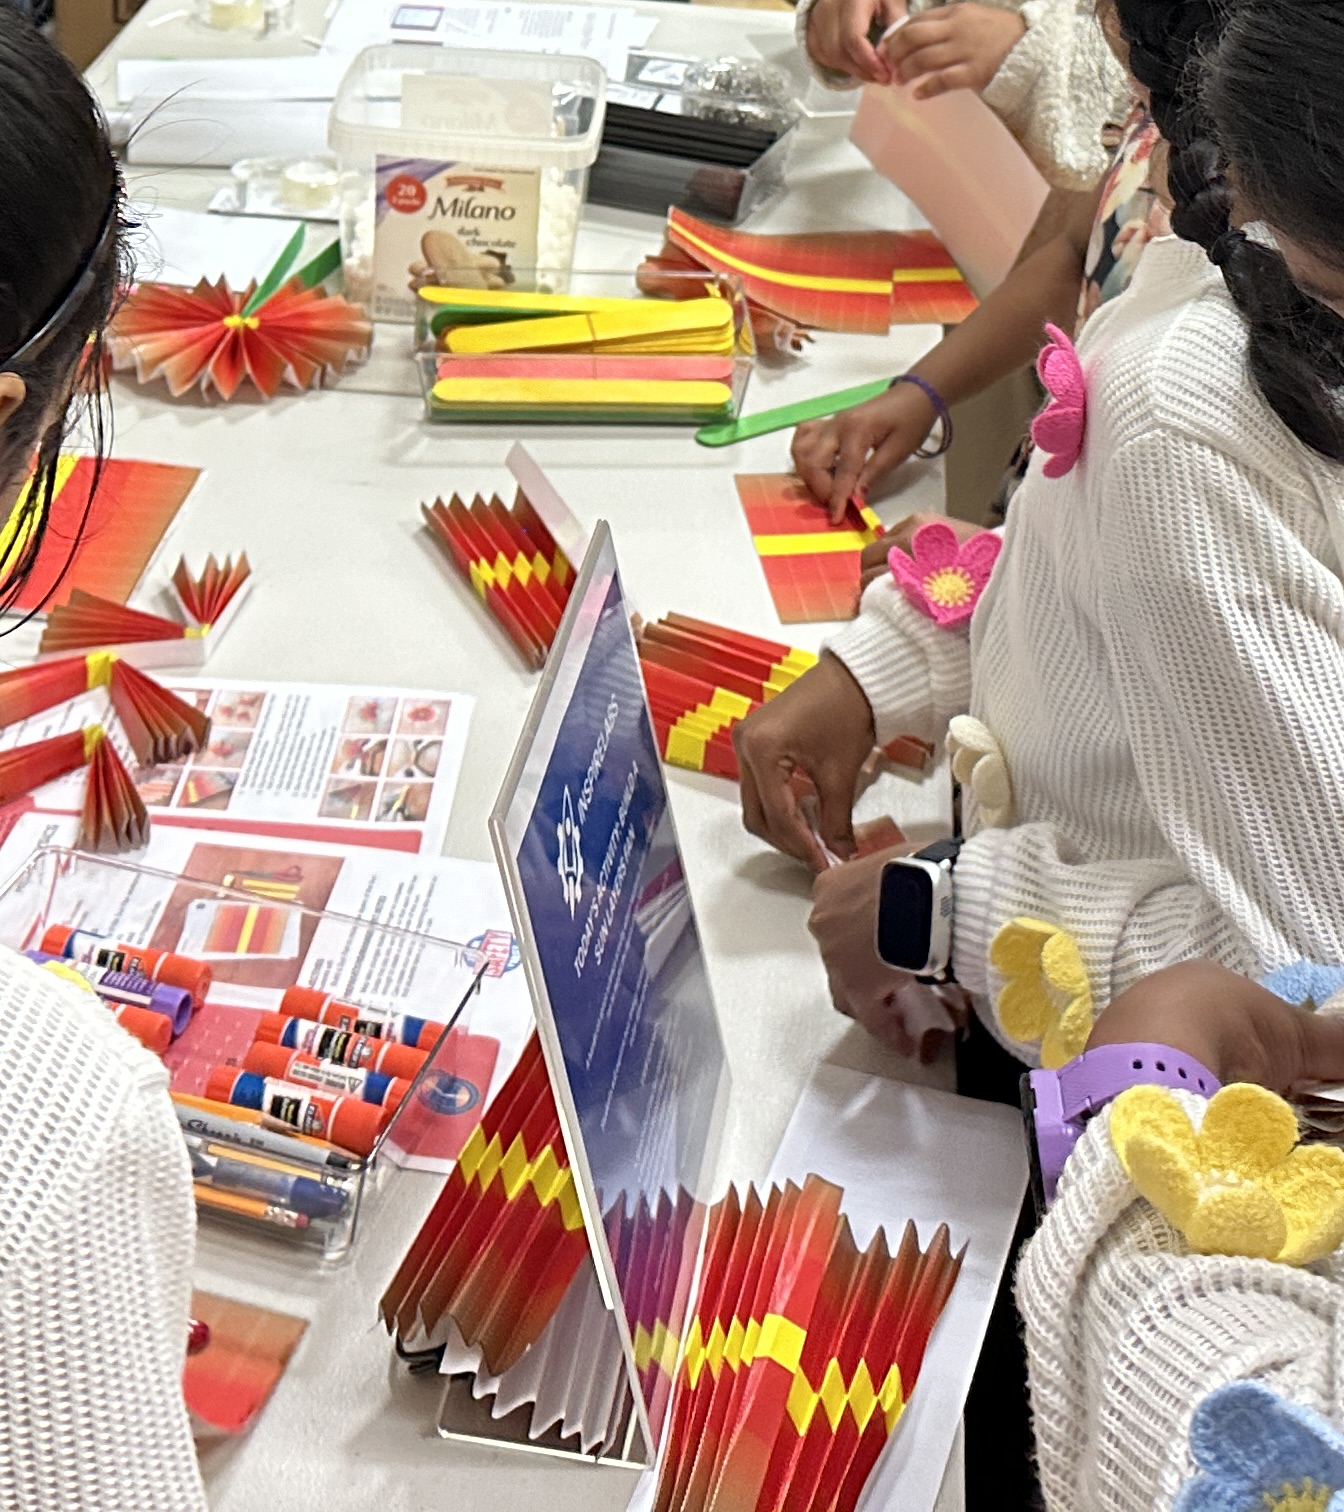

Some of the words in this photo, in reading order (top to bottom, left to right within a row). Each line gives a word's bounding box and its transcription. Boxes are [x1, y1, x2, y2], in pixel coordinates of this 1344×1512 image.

[428, 196, 517, 221] Milano
[465, 237, 517, 249] chocolate
[574, 895, 599, 979] TODAY'S
[594, 919, 609, 966] SUN
